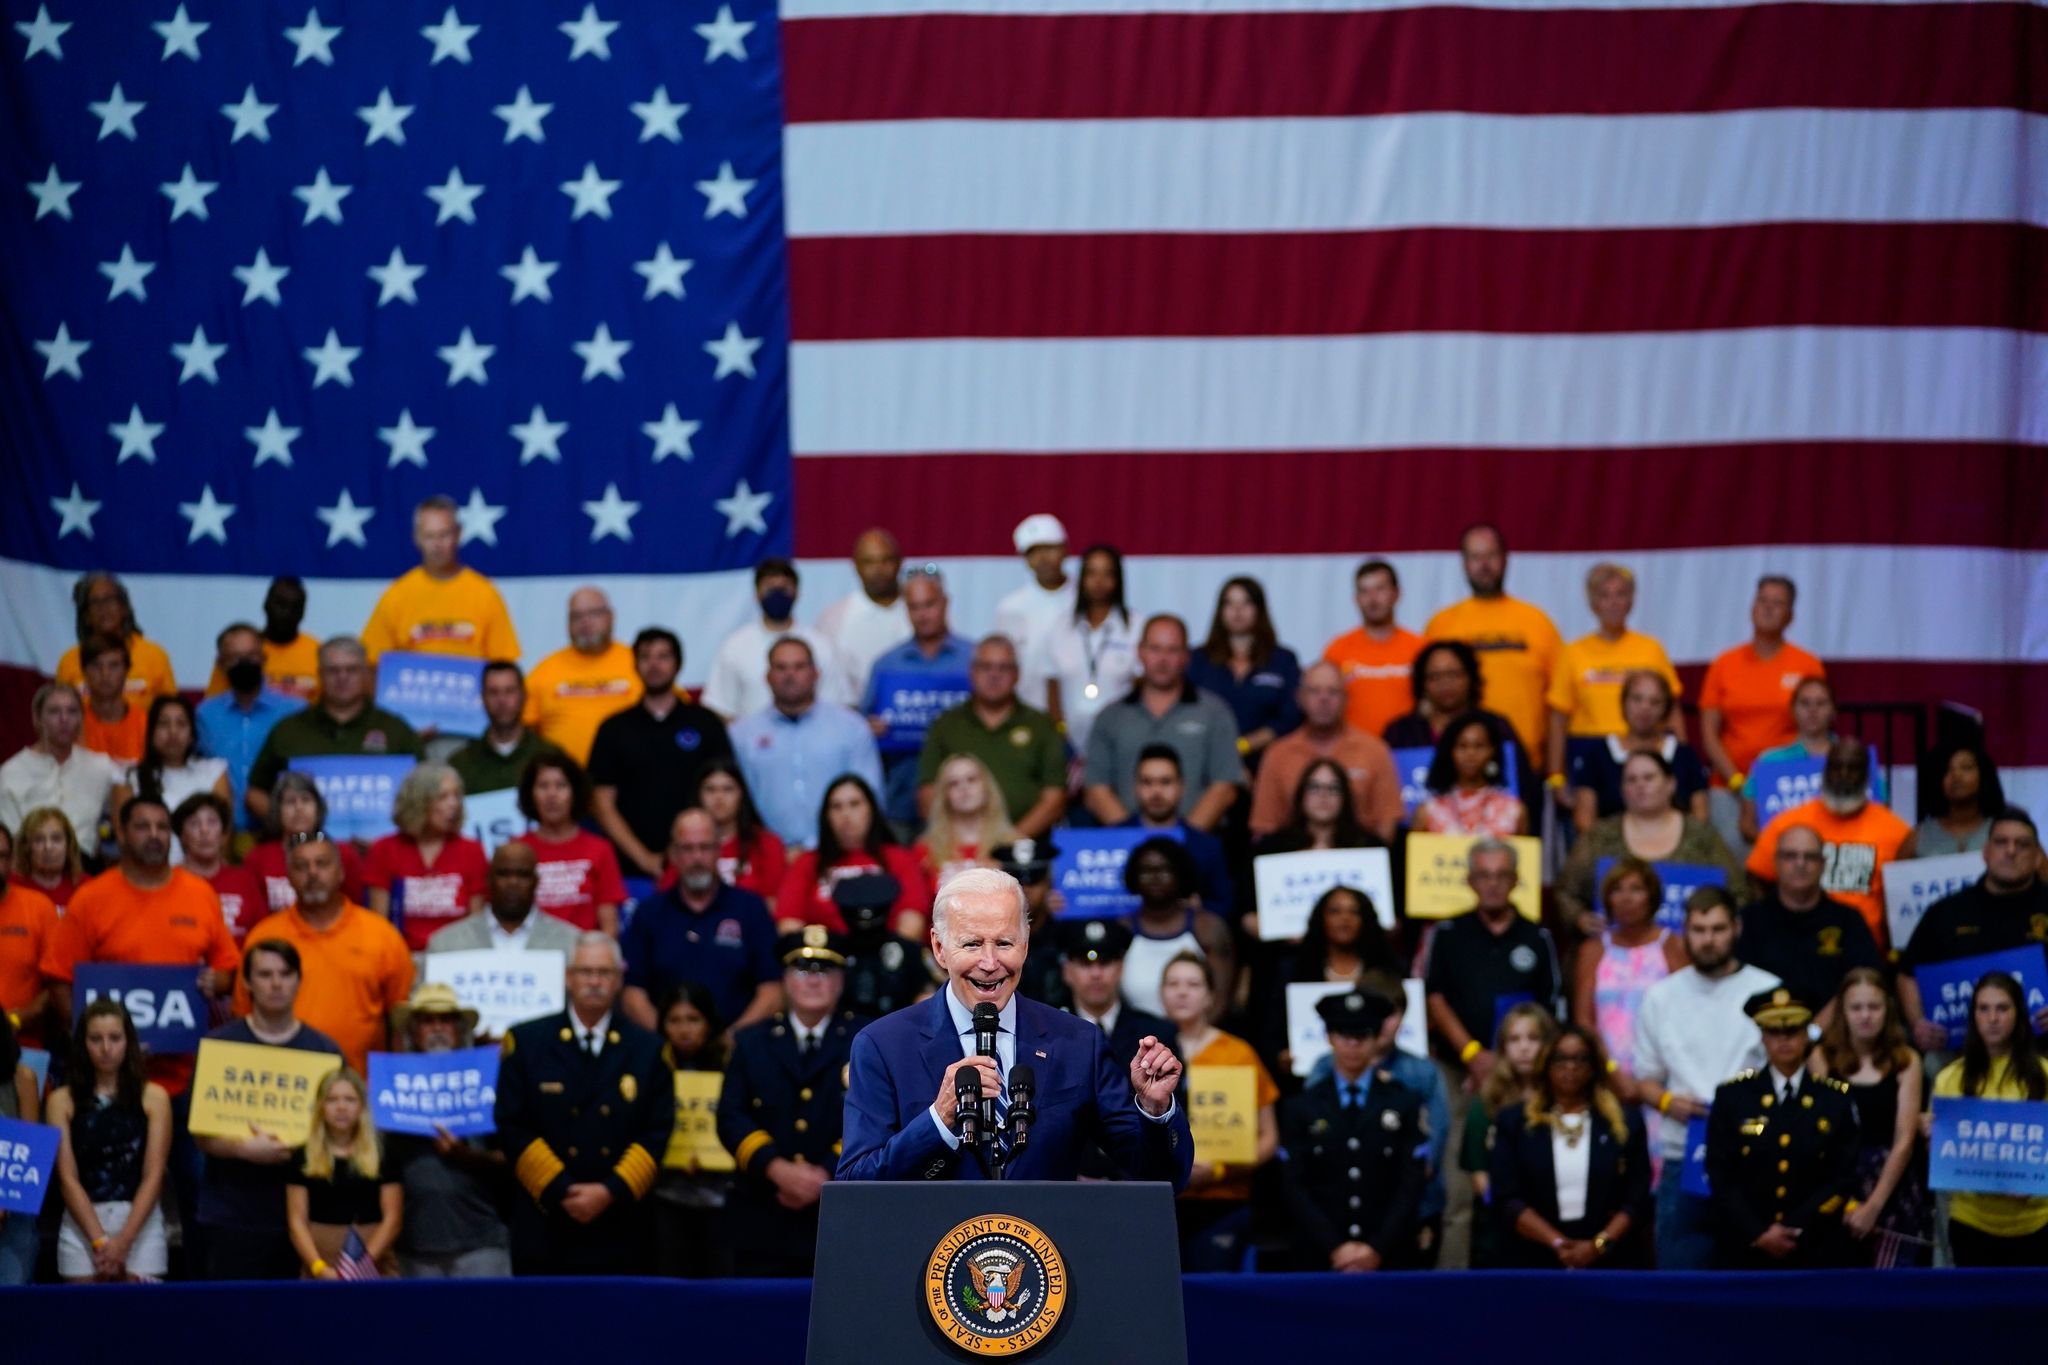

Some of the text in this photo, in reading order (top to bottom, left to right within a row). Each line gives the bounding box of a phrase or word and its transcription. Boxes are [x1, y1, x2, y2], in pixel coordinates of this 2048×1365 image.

[1077, 849, 1129, 869] SAF
[454, 971, 536, 987] SAFER
[224, 1066, 309, 1092] SAFER
[394, 1068, 481, 1092] SAFER
[204, 1086, 314, 1114] AMERIC
[379, 1085, 497, 1112] AMERICA
[1957, 1119, 2045, 1142] SAFER
[931, 1220, 1063, 1350] SEAL OF THE PRESIDENT OF THE UNITED STATES
